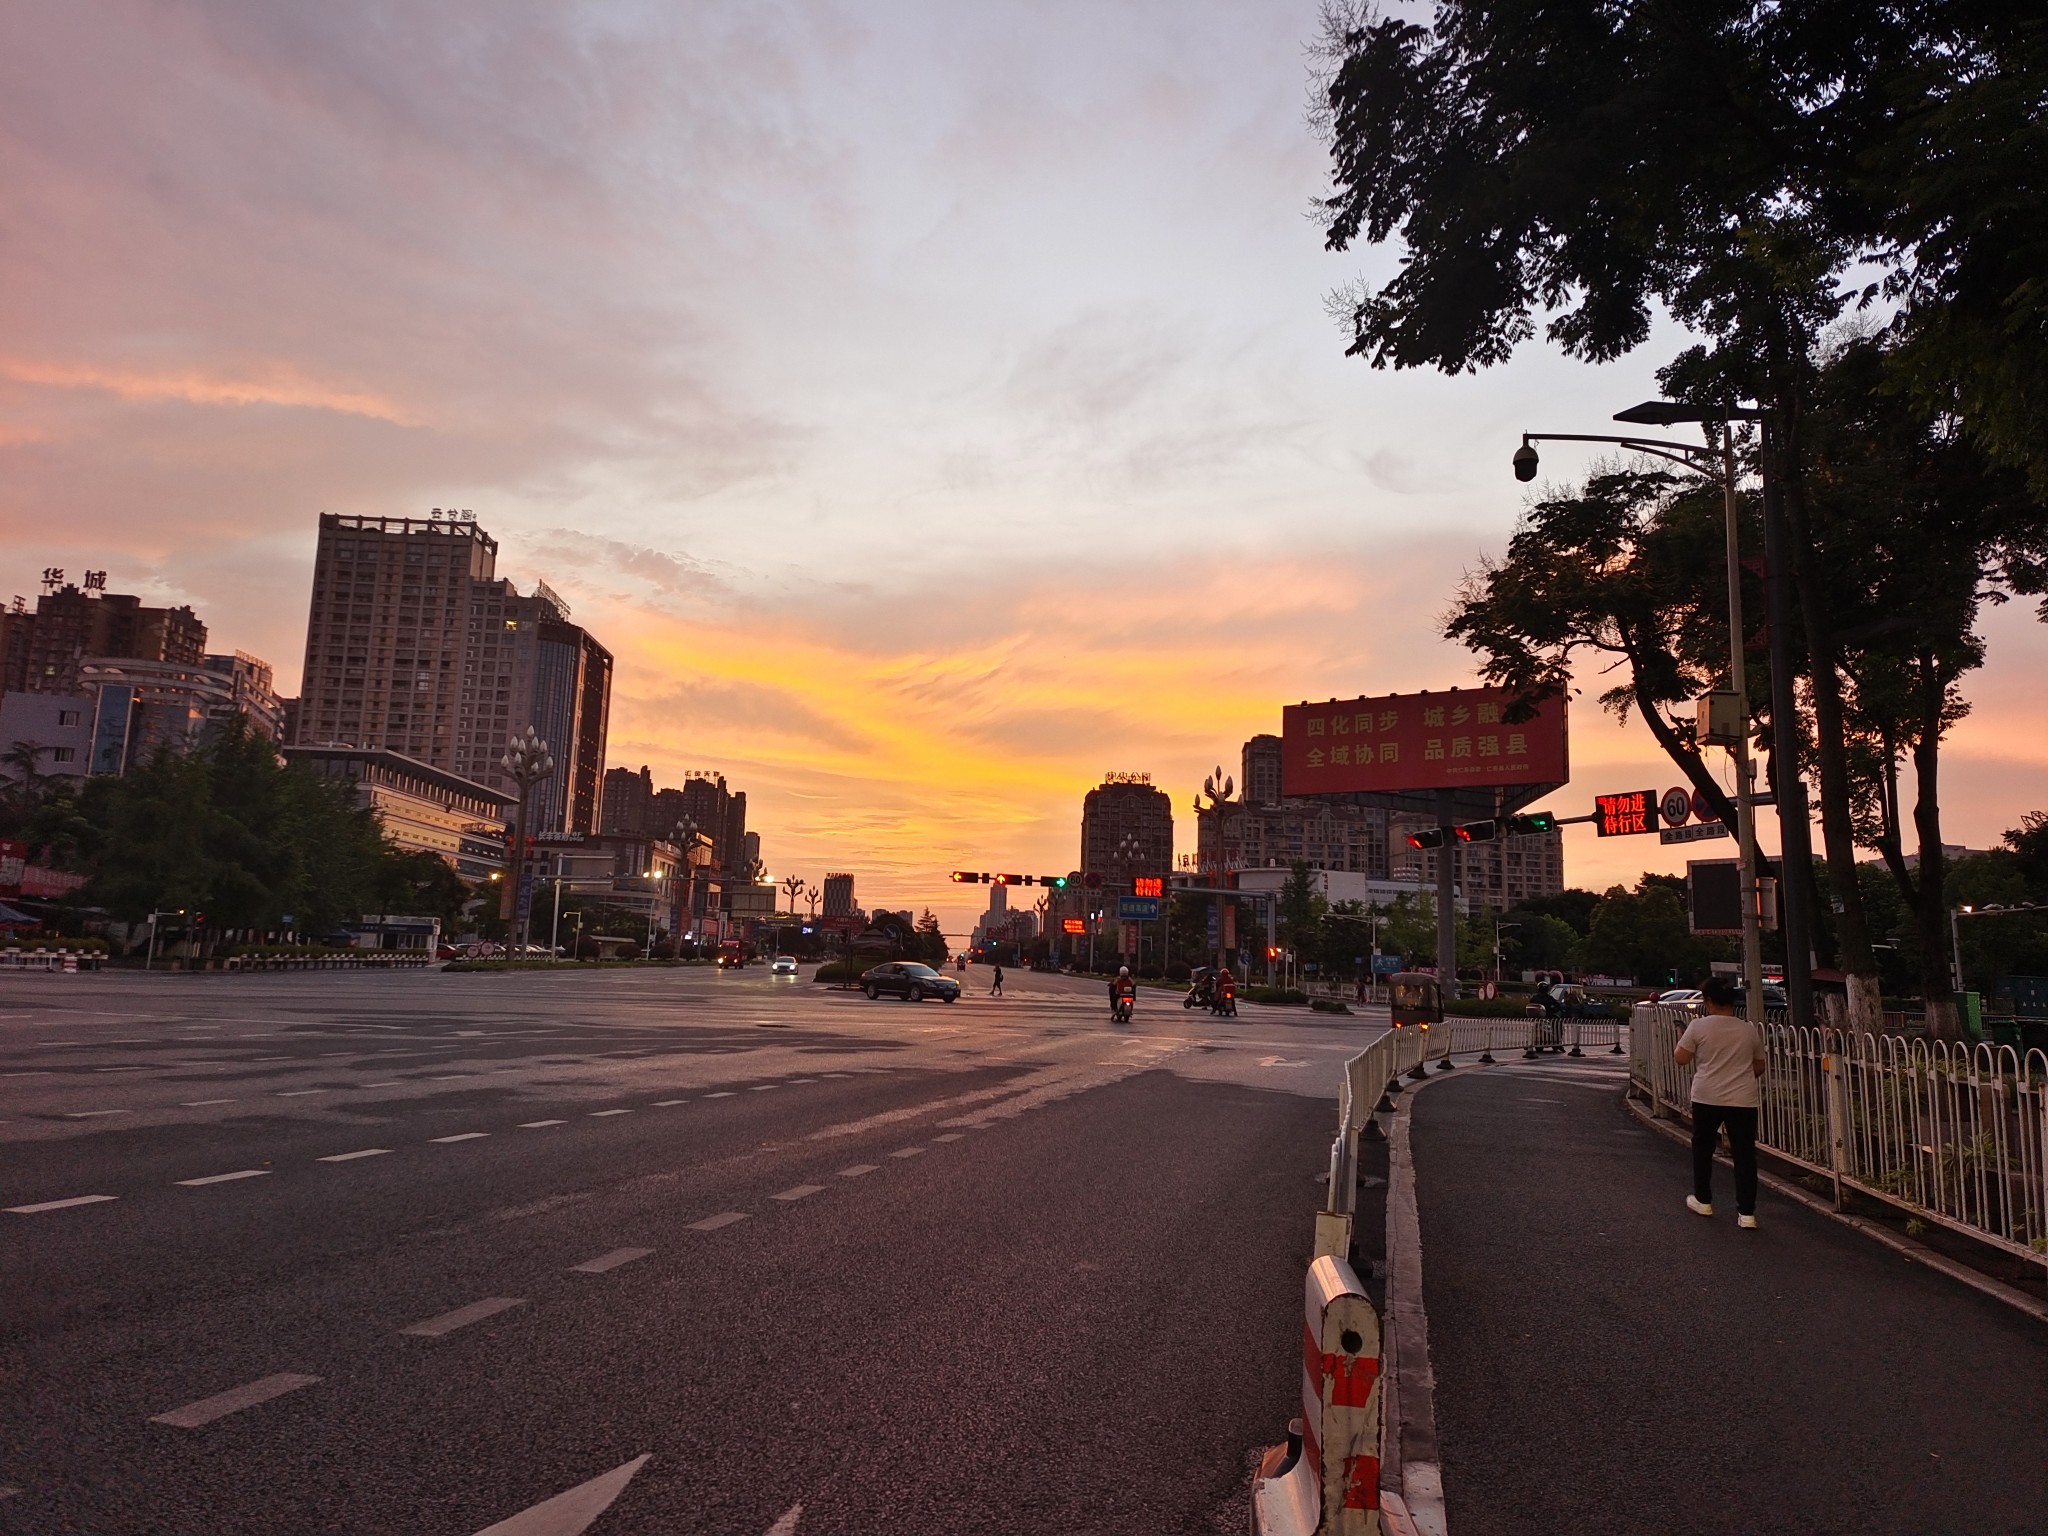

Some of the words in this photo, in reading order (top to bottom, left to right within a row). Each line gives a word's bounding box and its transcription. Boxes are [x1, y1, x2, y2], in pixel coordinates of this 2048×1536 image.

[41, 568, 107, 590] 华城
[1307, 711, 1399, 737] 四化同步
[1424, 703, 1501, 728] 城乡融
[1306, 742, 1399, 768] 全域协同
[1424, 734, 1528, 761] 品质强县
[1603, 794, 1646, 815] 请勿进
[1667, 797, 1685, 817] 60
[1604, 813, 1647, 834] 待行区
[1696, 824, 1726, 837] 全路段
[1664, 829, 1691, 842] 全路段
[1070, 876, 1081, 884] 60
